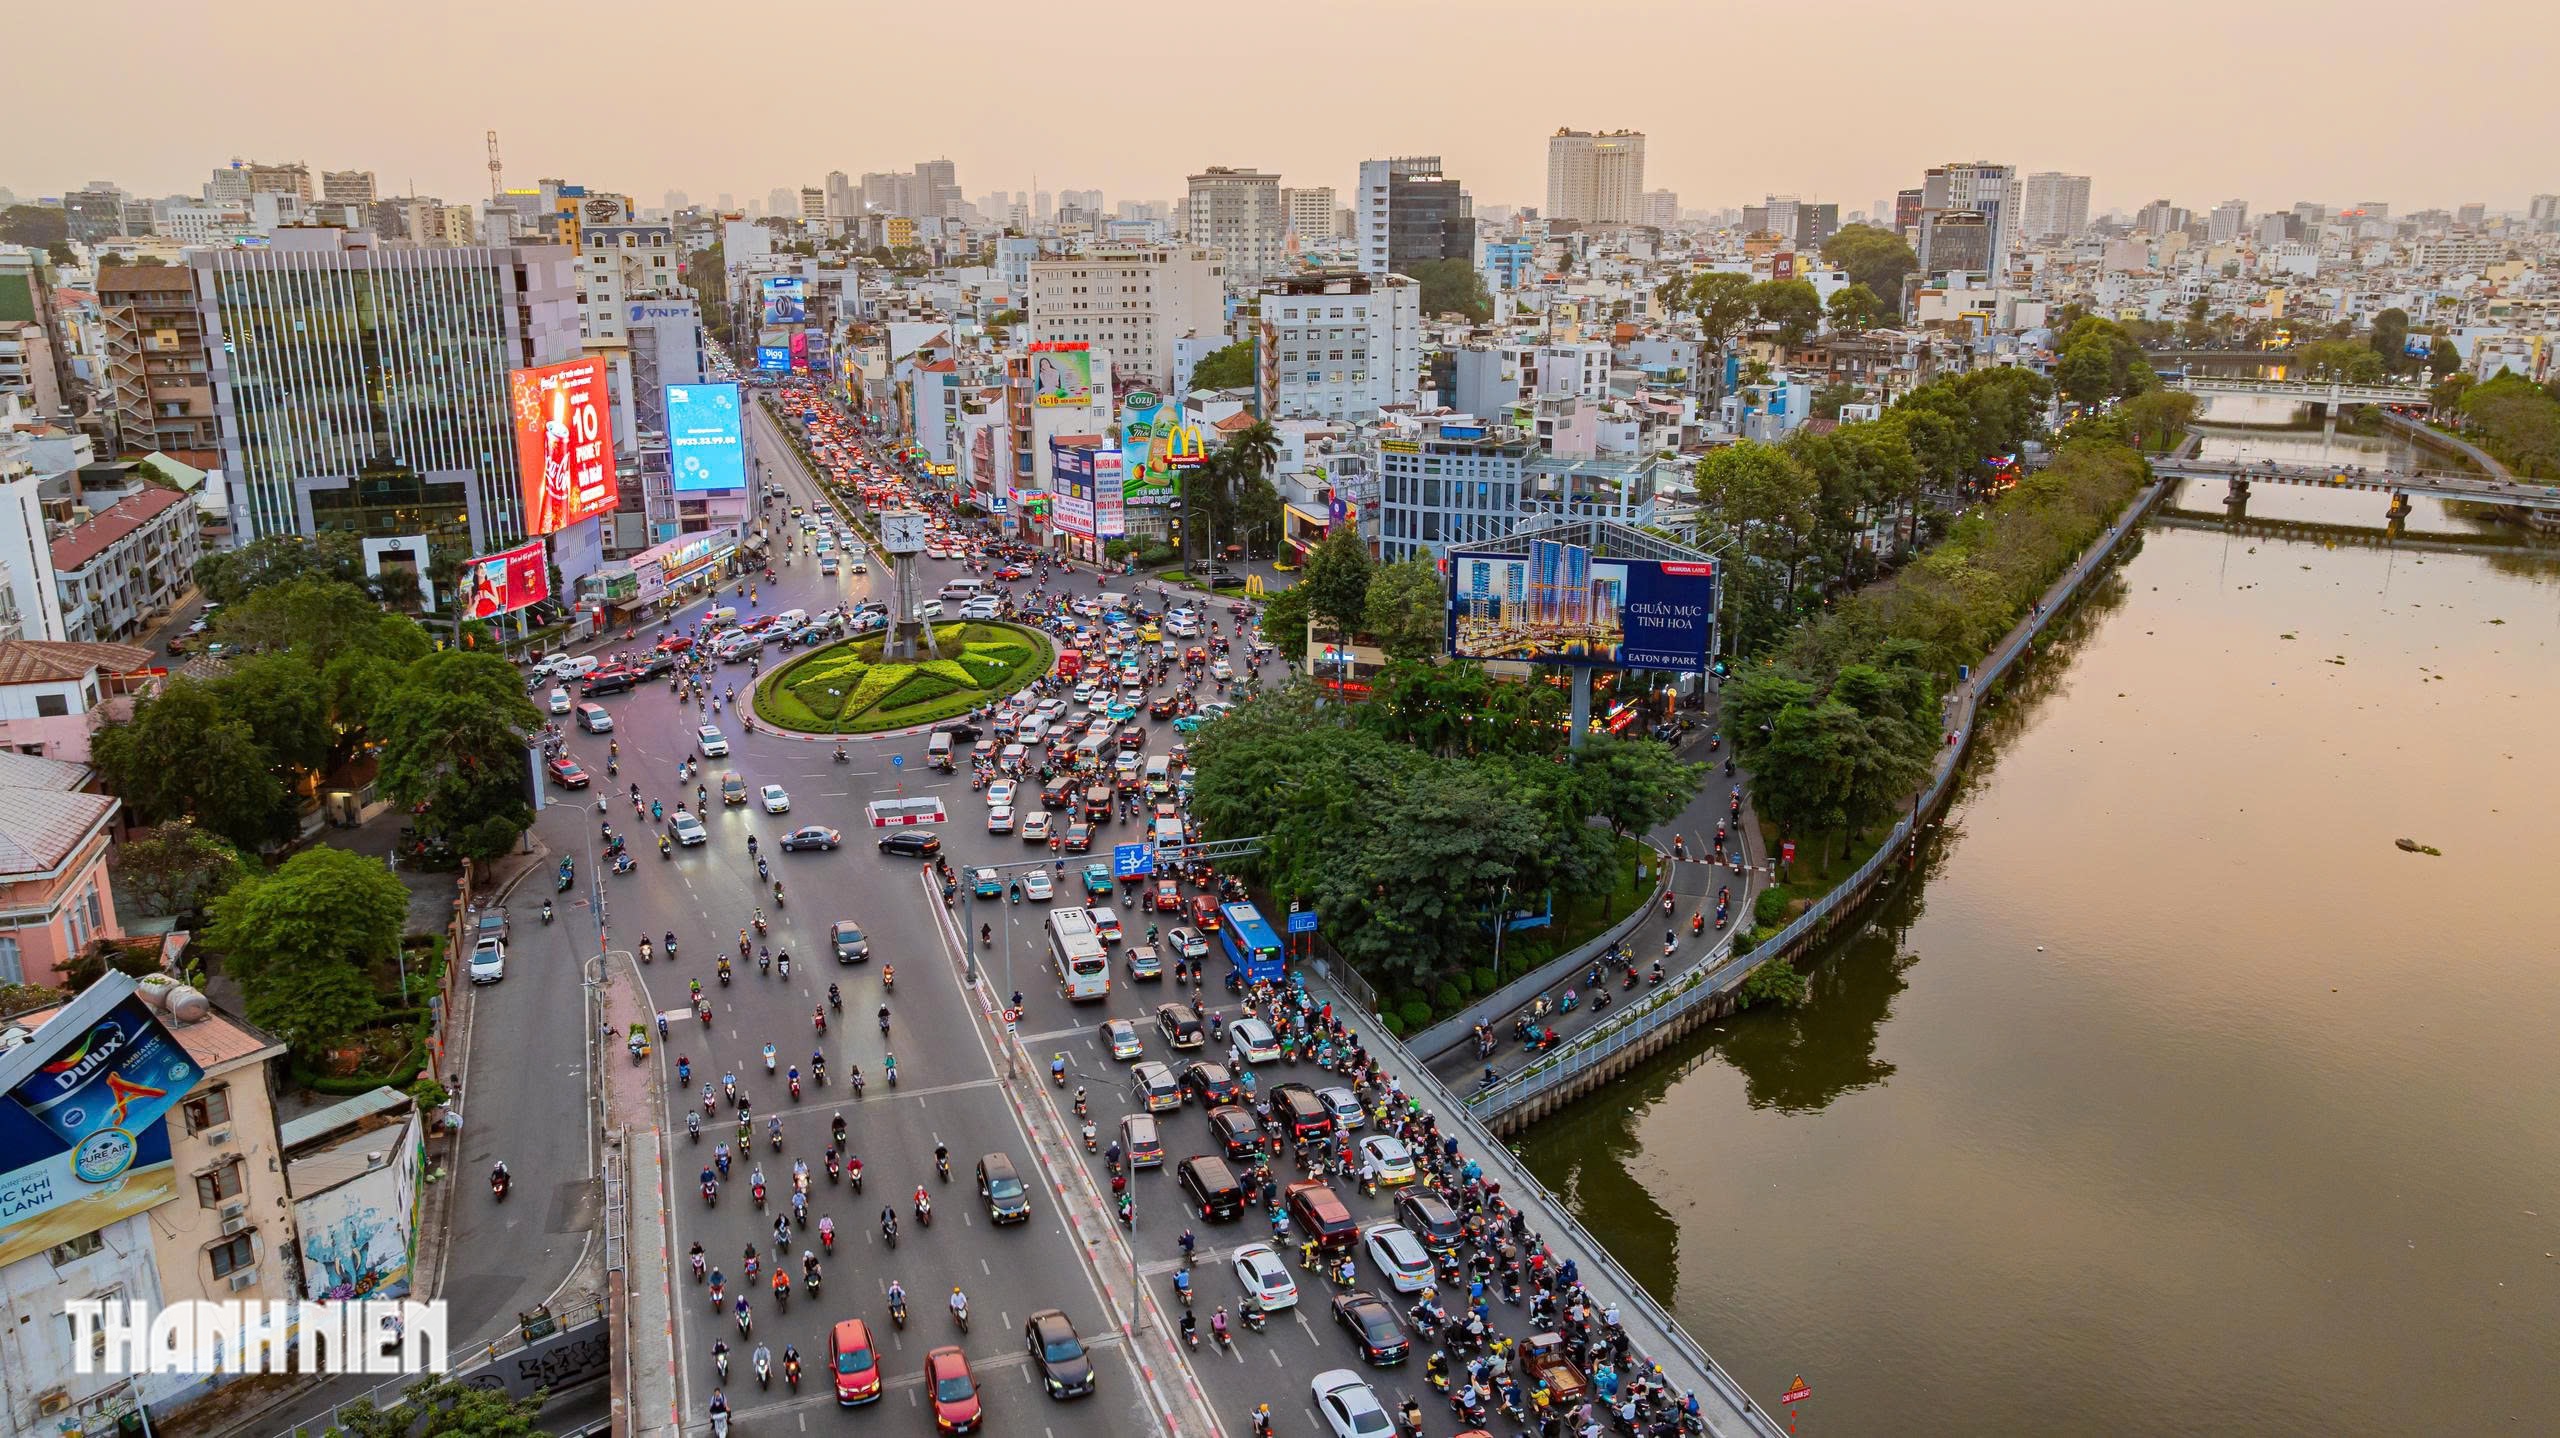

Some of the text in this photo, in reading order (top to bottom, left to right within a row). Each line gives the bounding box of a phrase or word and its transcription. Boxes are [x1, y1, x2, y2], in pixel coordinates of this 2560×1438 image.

[647, 308, 689, 317] VNPT
[1129, 395, 1153, 405] Cozy
[572, 404, 598, 443] 10
[1630, 601, 1702, 618] CHUẨN MỰC
[1637, 616, 1693, 629] TINH HOA
[1628, 653, 1697, 665] EATON PARK
[122, 1034, 161, 1069] AMBIANCE
[54, 1036, 123, 1090] Dulux
[78, 1142, 130, 1166] PURE AIR
